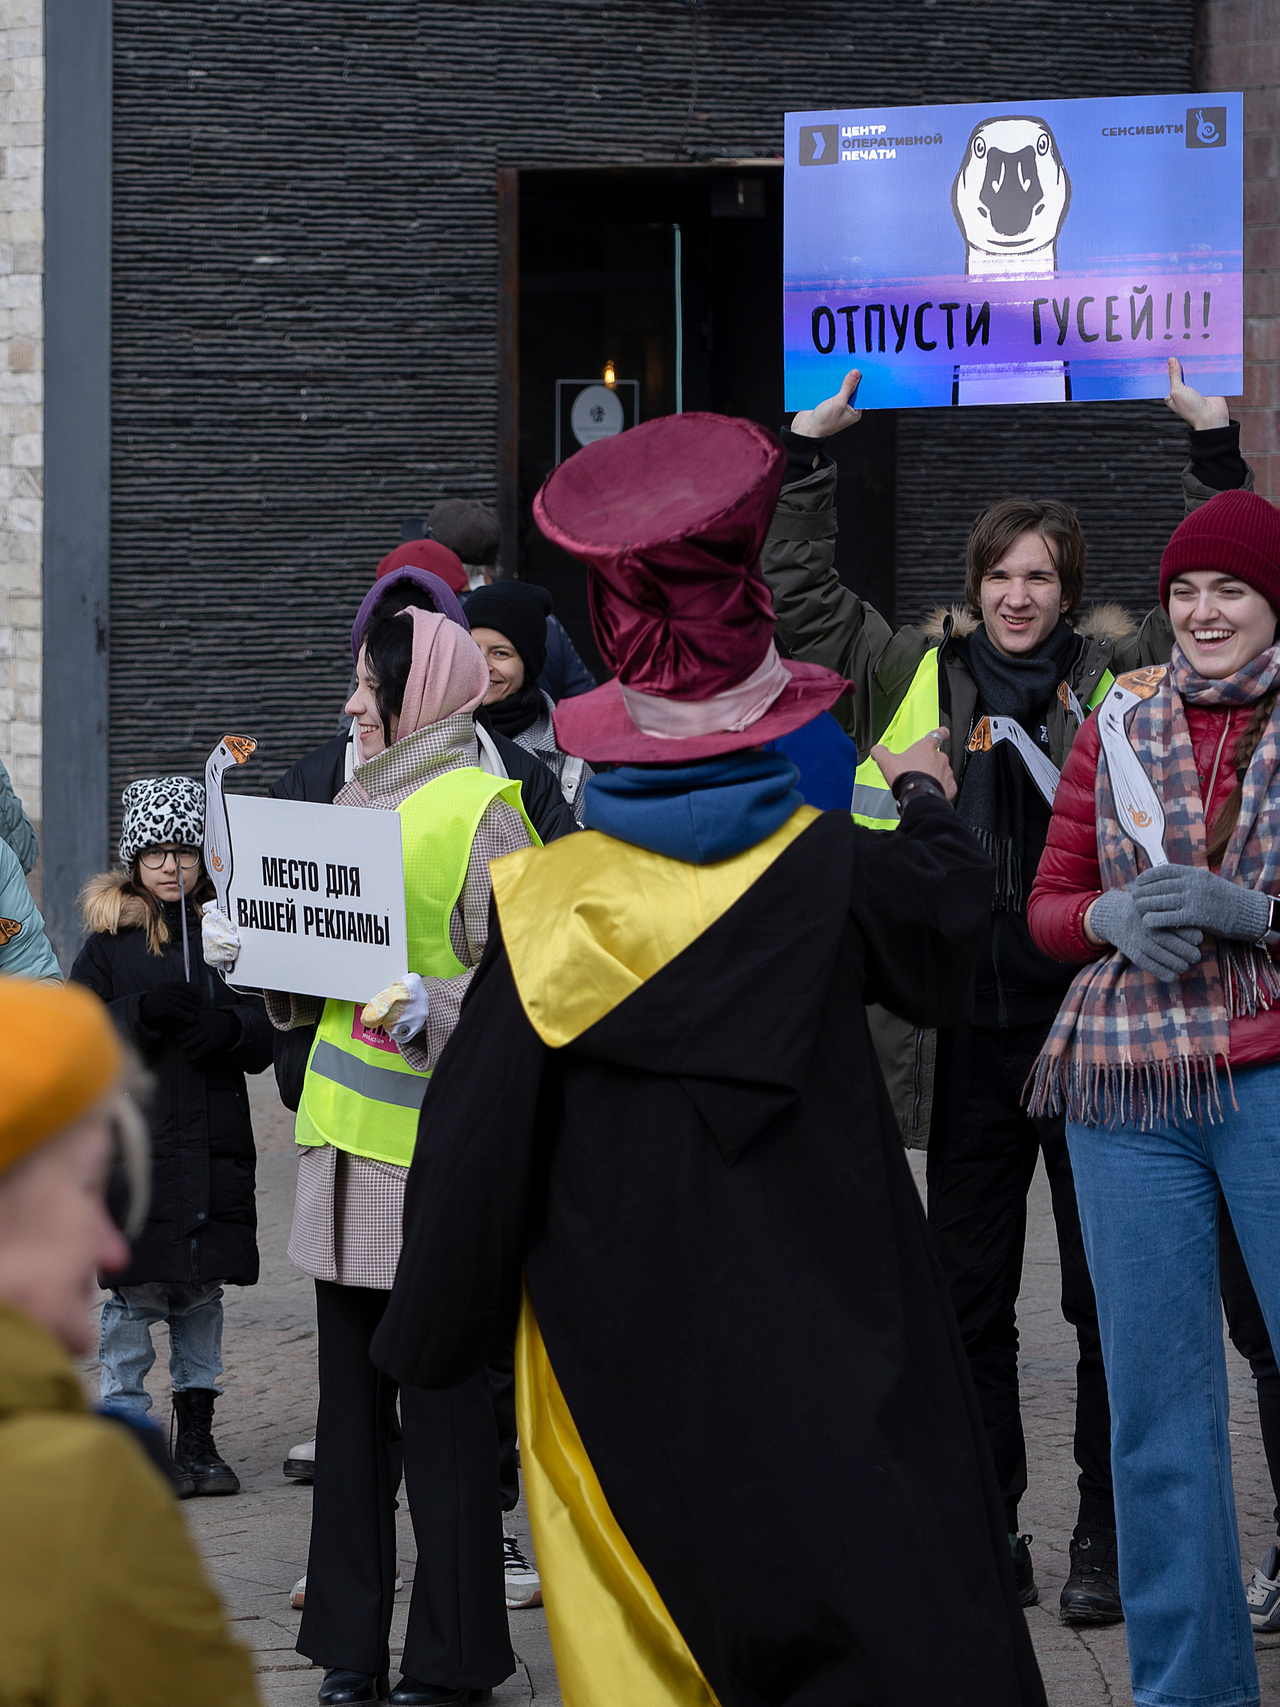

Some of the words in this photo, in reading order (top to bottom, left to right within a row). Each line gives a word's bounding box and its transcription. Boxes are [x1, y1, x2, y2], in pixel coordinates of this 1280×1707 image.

[841, 124, 887, 138] ЦЕНТР
[1101, 124, 1184, 137] СЕНСИВИТИ
[841, 133, 944, 149] ОПЕРАТИВНОЙ
[841, 148, 897, 162] ПЕЧАТИ
[811, 301, 991, 355] ОТПУСТИ
[1032, 284, 1212, 346] ГУСЕЙ!!!
[261, 855, 320, 893] МЕСТО
[325, 863, 362, 900] ДЛЯ
[237, 897, 298, 934] ВАШЕЙ
[303, 905, 391, 947] РЕКЛАМЫ
[361, 1032, 385, 1045] production
